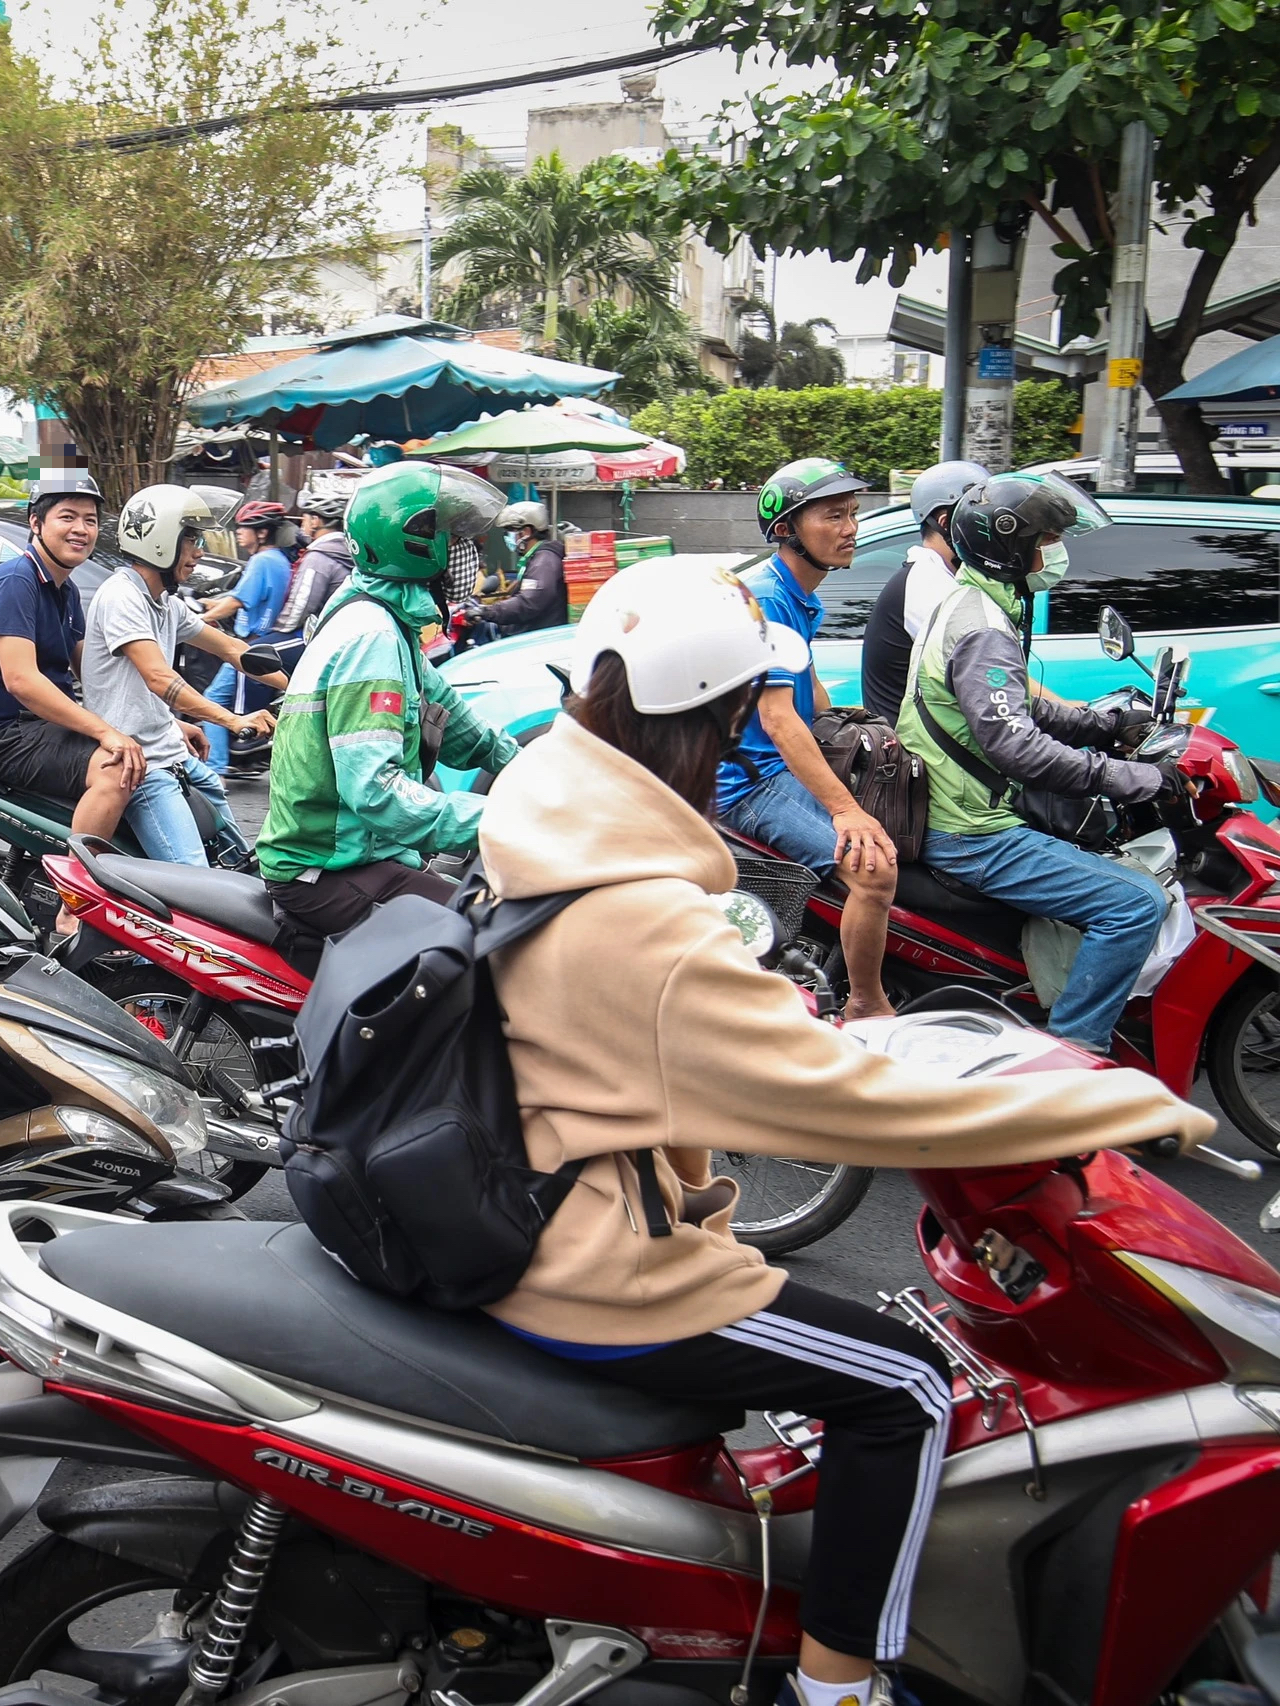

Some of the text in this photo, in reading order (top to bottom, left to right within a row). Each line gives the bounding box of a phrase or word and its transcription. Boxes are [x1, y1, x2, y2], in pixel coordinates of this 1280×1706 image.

[539, 468, 552, 478] 27
[555, 468, 568, 477] 27
[91, 1159, 141, 1177] HONDA
[254, 1447, 496, 1539] AIR BLADE
